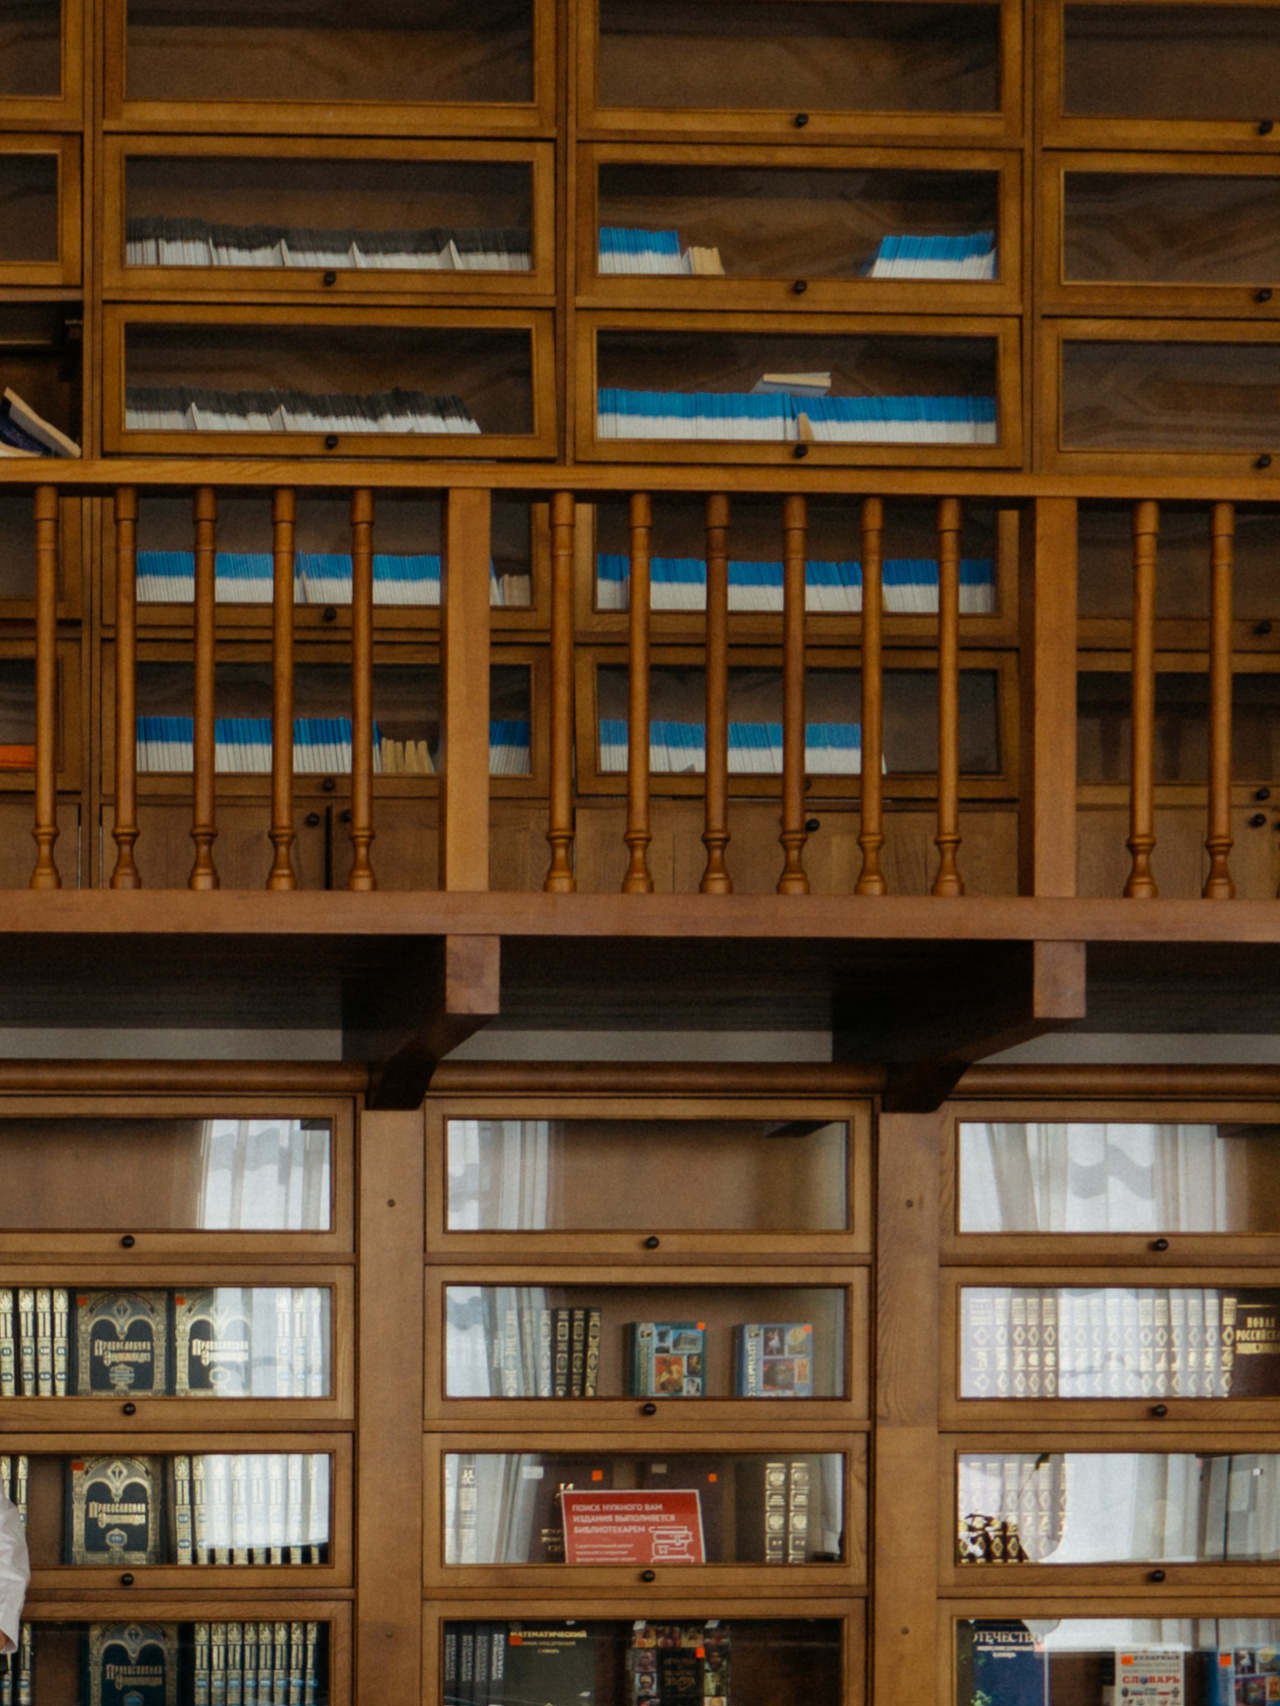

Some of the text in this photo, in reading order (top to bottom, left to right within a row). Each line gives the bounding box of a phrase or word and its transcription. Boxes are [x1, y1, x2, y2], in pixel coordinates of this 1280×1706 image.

[1236, 1329, 1280, 1341] РОССИЙСК
[572, 1503, 663, 1512] ПОИСК НУЖНОГО ВАМ
[573, 1514, 675, 1523] ИЗДАНИЯ ВЫПОЛНЯЕТСЯ
[574, 1526, 646, 1534] БИБЛИОТЕКАРЕМ
[1122, 1676, 1180, 1684] СЛОВАРЬ
